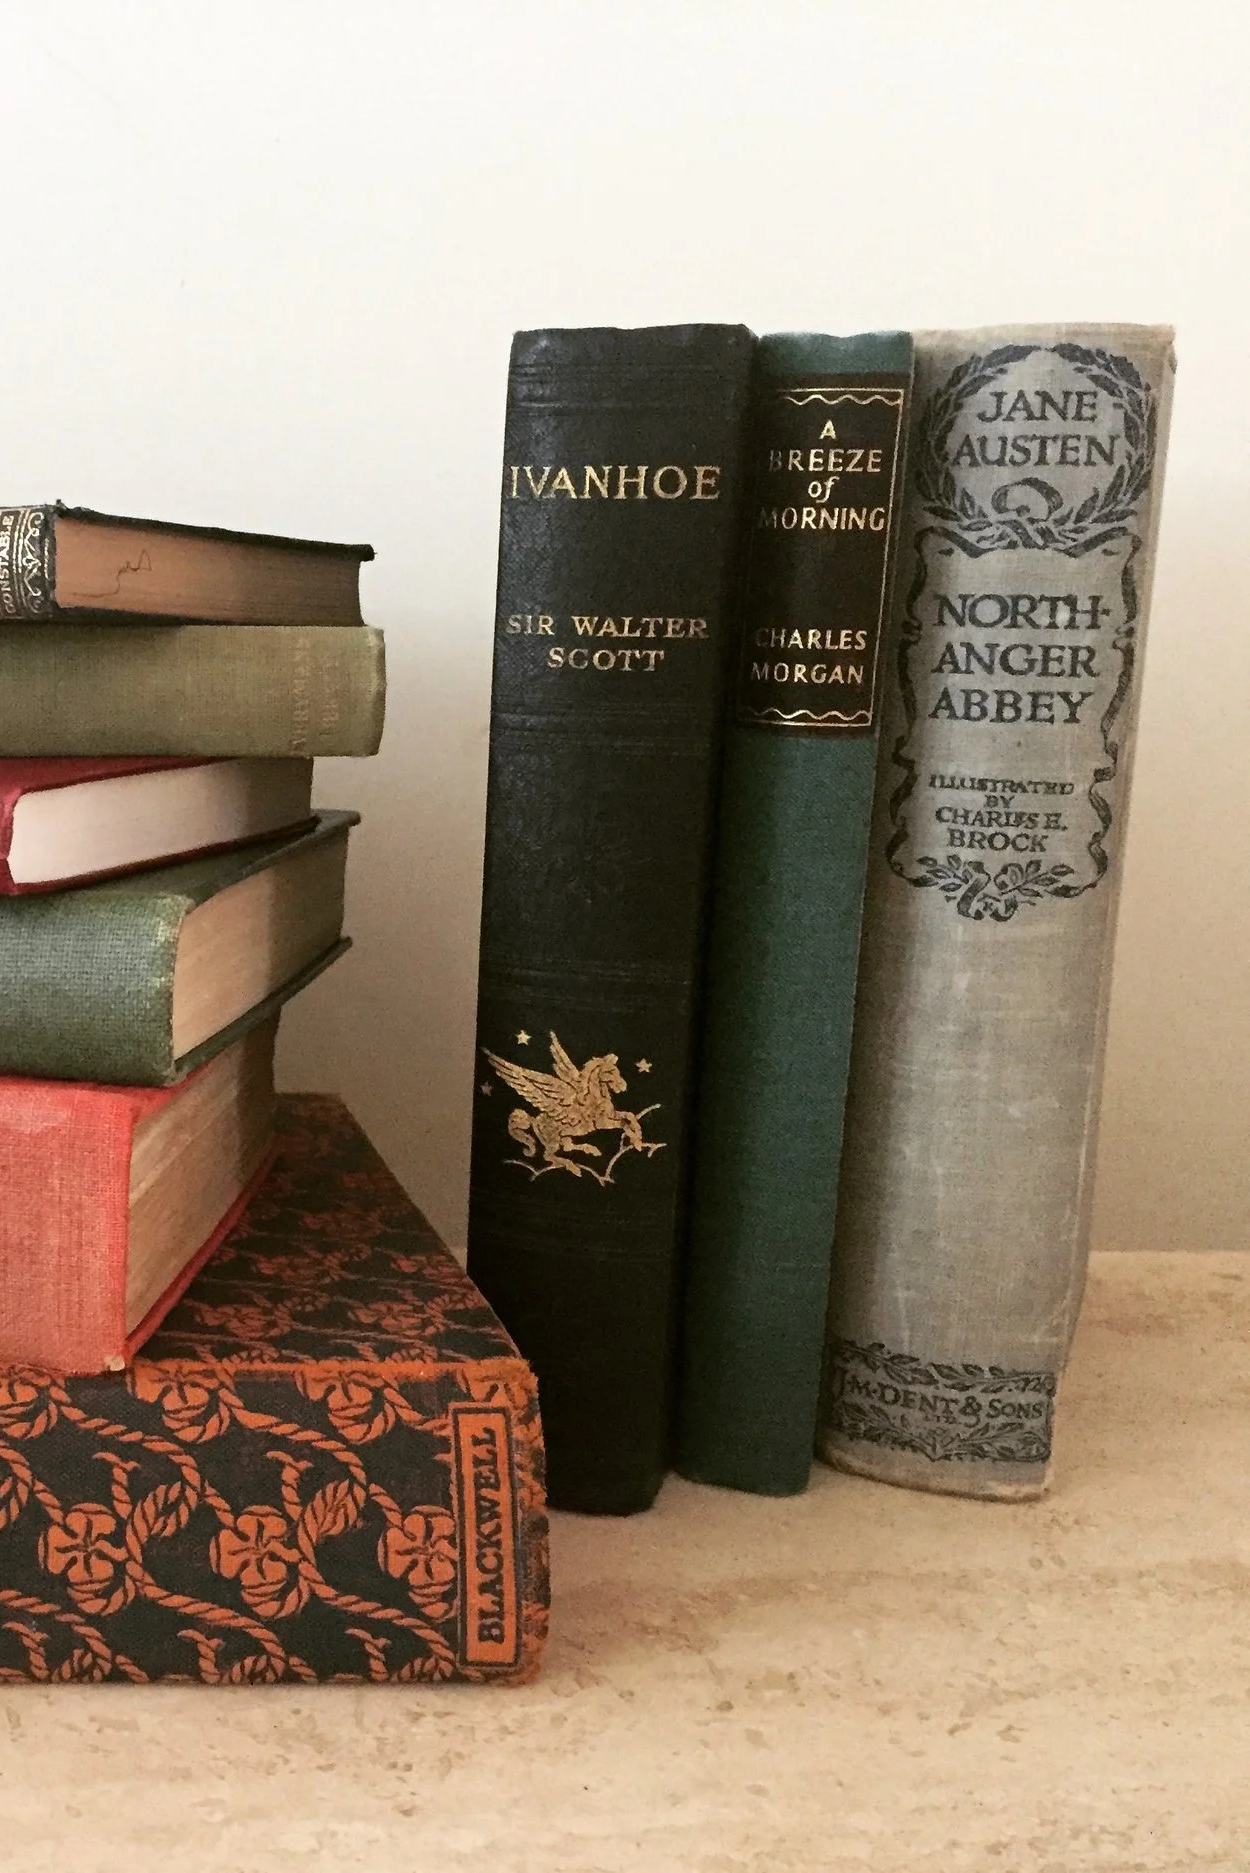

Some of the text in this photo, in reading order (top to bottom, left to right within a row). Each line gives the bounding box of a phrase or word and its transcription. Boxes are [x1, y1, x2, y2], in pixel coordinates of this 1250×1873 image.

[977, 389, 1098, 423] JANE
[819, 420, 837, 440] A
[769, 449, 883, 474] BREEZE
[952, 433, 1120, 467] AUSTEN
[509, 465, 721, 500] IVANHOE
[807, 476, 840, 503] of
[758, 506, 886, 531] MORNING
[933, 593, 1112, 630] NORTH-
[506, 614, 709, 639] SIR WALTER
[755, 628, 868, 651] CHARLES
[547, 646, 665, 672] SCOTT
[931, 641, 1100, 678] ANGER
[750, 662, 864, 684] MORGAN
[928, 686, 1095, 724] ABBEY
[928, 774, 1075, 796] ILLUSTRATED
[984, 795, 1015, 810] BY
[935, 806, 1040, 828] CHARLES
[946, 828, 1049, 853] BROCK
[985, 1399, 1043, 1419] SONS
[471, 1427, 505, 1644] BLACKWELL
